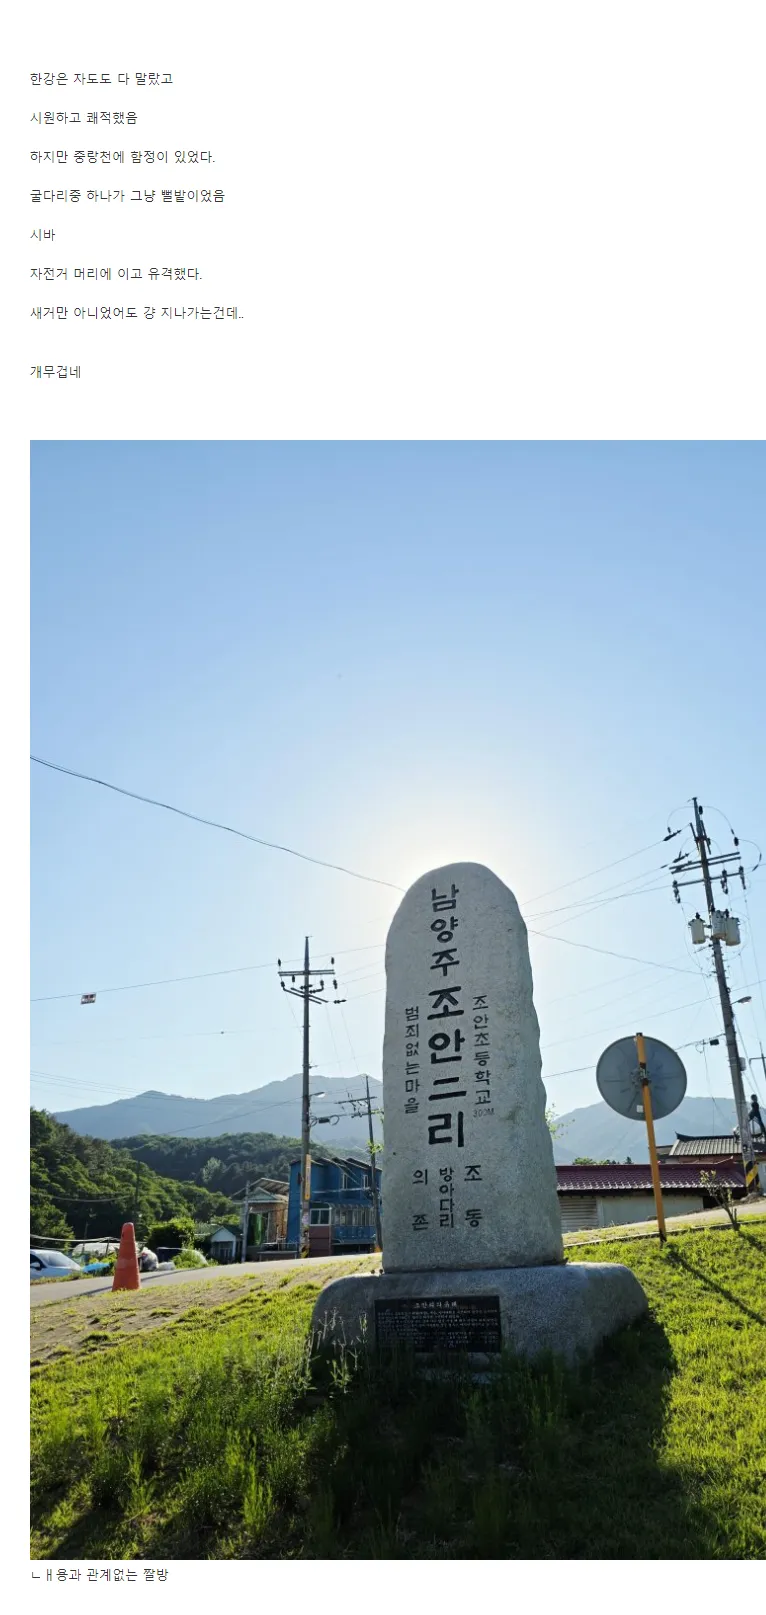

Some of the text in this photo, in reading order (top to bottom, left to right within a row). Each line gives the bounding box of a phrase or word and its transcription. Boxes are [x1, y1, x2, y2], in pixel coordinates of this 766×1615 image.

[430, 883, 460, 977] 남양주
[404, 1005, 420, 1114] 범죄없는마을
[472, 994, 491, 1105] 조안초등학교
[439, 1166, 455, 1229] 방아다리
